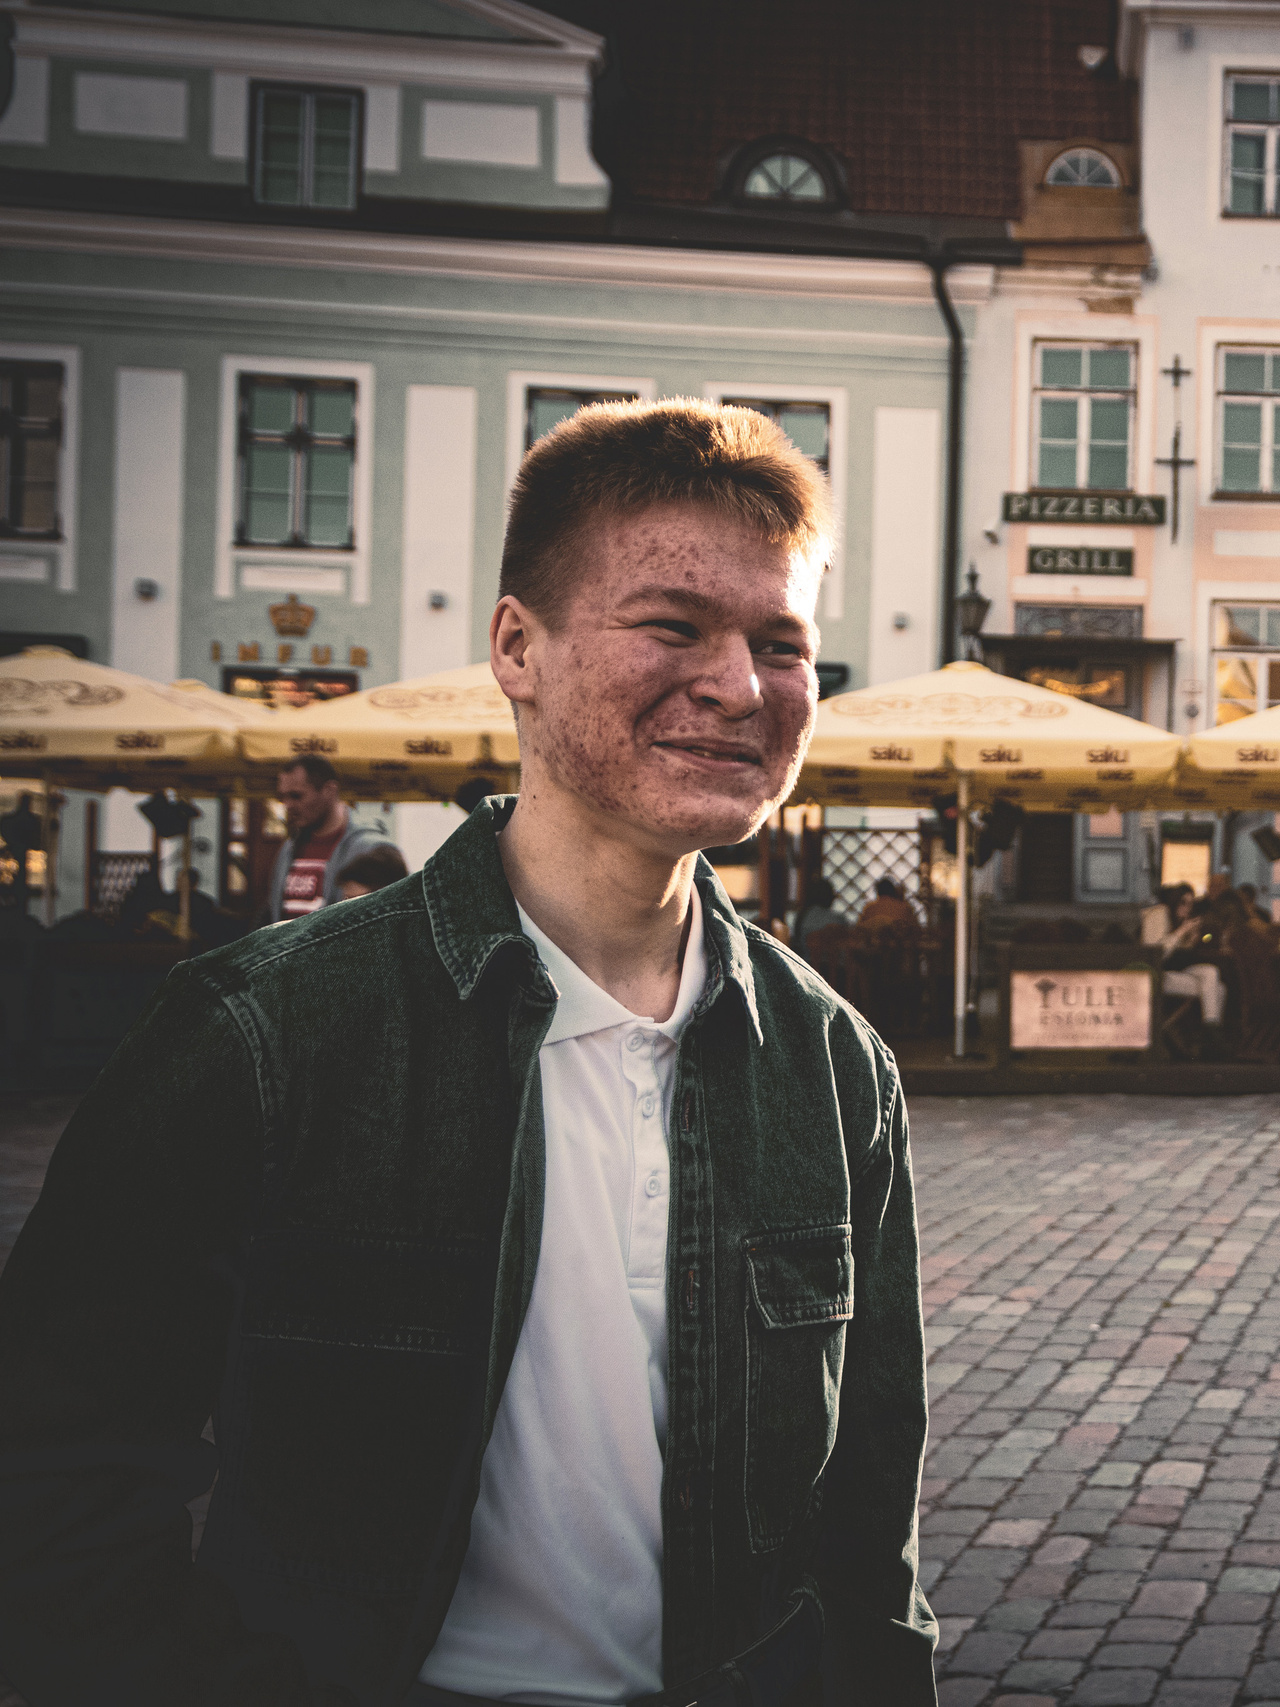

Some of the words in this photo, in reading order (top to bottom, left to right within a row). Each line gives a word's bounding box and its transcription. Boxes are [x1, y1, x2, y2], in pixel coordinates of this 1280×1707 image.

[1009, 496, 1158, 518] PIZZERIA
[1033, 550, 1124, 570] GRILL
[290, 735, 338, 753] saku
[404, 737, 452, 756] saku
[870, 744, 914, 761] saku
[980, 745, 1022, 763] saku
[1086, 746, 1129, 763] saku
[1237, 745, 1279, 762] saku
